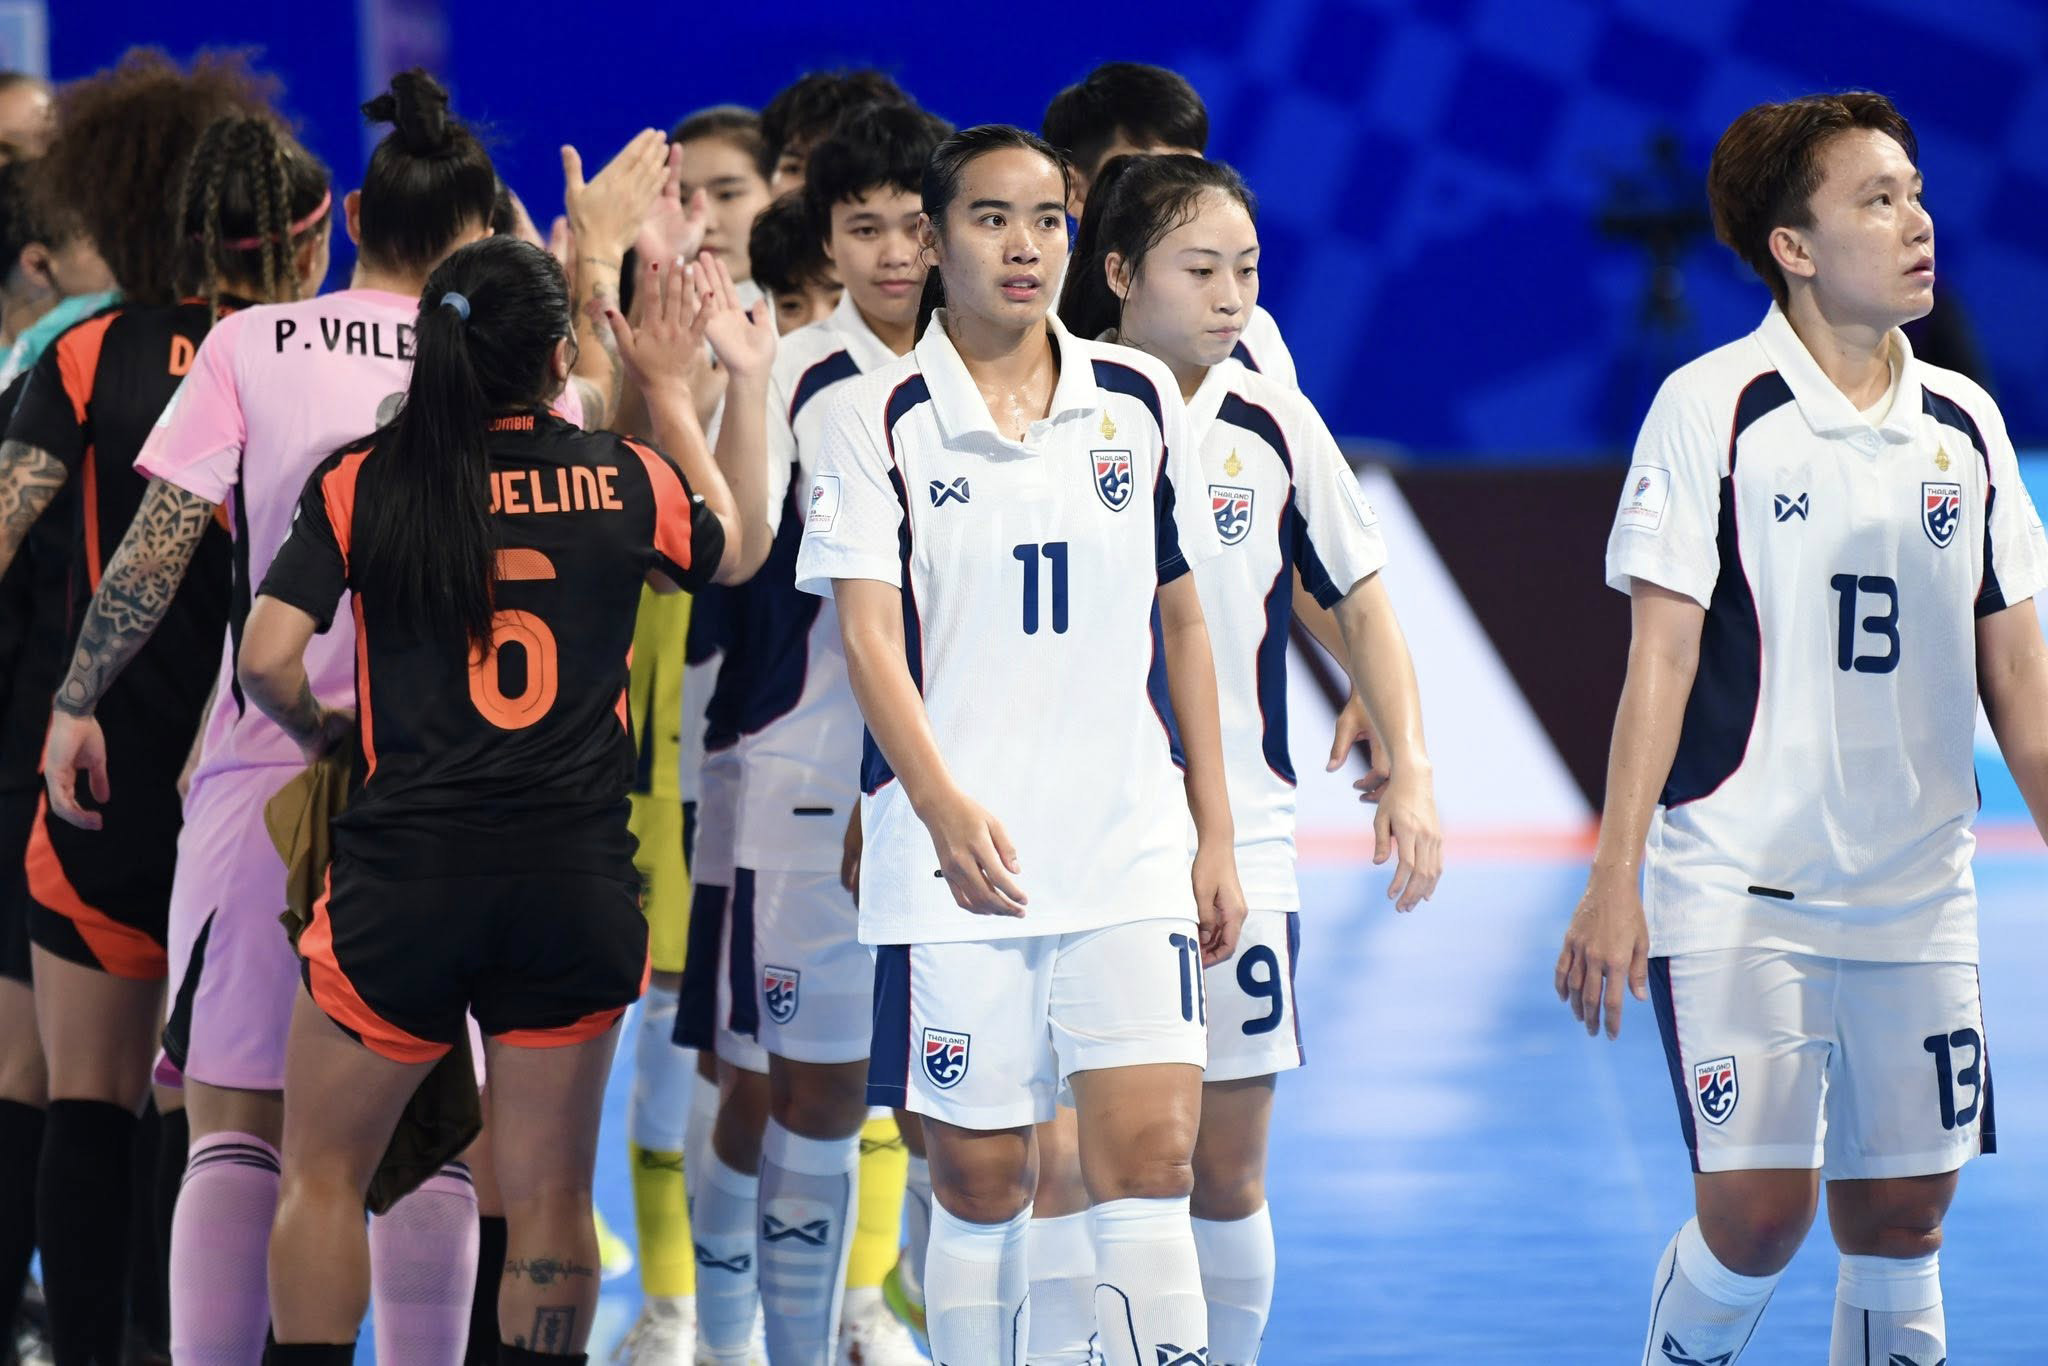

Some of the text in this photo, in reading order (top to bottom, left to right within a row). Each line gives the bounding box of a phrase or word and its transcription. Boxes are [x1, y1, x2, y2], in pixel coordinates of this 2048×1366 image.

[168, 334, 195, 377] D
[489, 416, 535, 431] OMBIA
[1213, 490, 1250, 501] THAILAND
[1012, 541, 1069, 635] 11
[467, 548, 559, 730] 6
[1830, 573, 1901, 674] 13
[1236, 944, 1284, 1036] 9
[927, 1033, 966, 1046] THAILAND
[1698, 1062, 1732, 1075] THAILAND
[1923, 1027, 1982, 1131] 13
